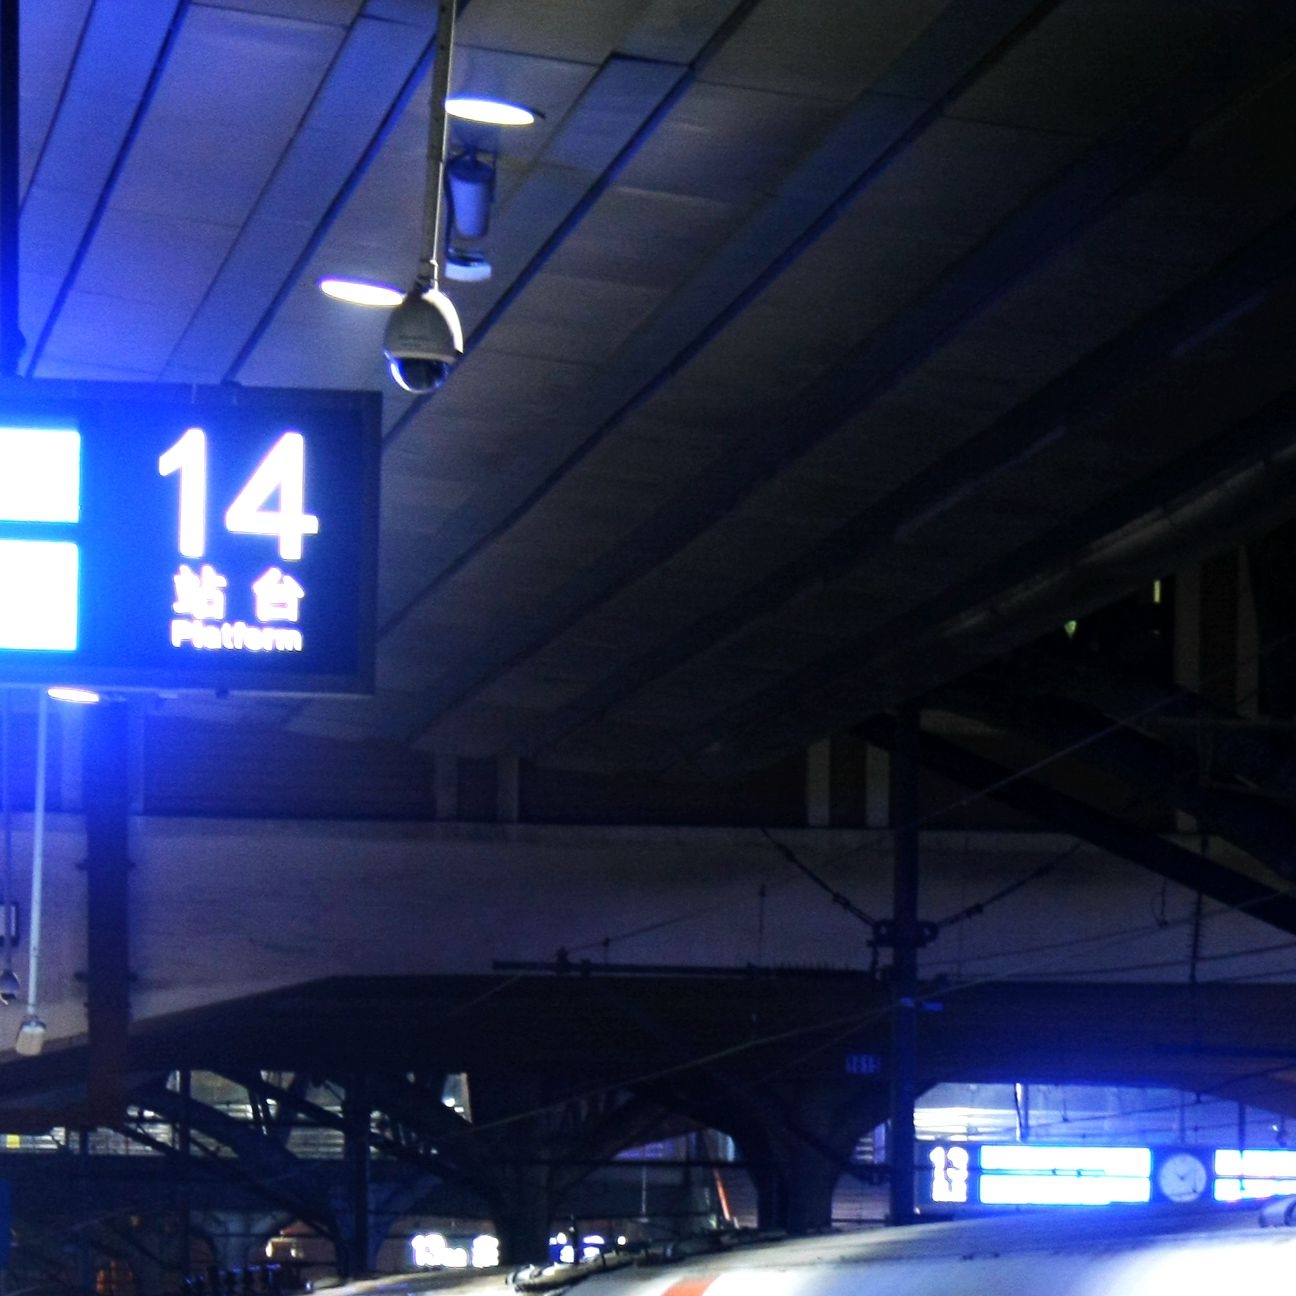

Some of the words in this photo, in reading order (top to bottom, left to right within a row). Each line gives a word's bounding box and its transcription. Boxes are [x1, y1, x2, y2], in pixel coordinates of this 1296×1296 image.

[159, 427, 319, 561] 14
[173, 564, 305, 622] 站台
[170, 619, 304, 652] Platform
